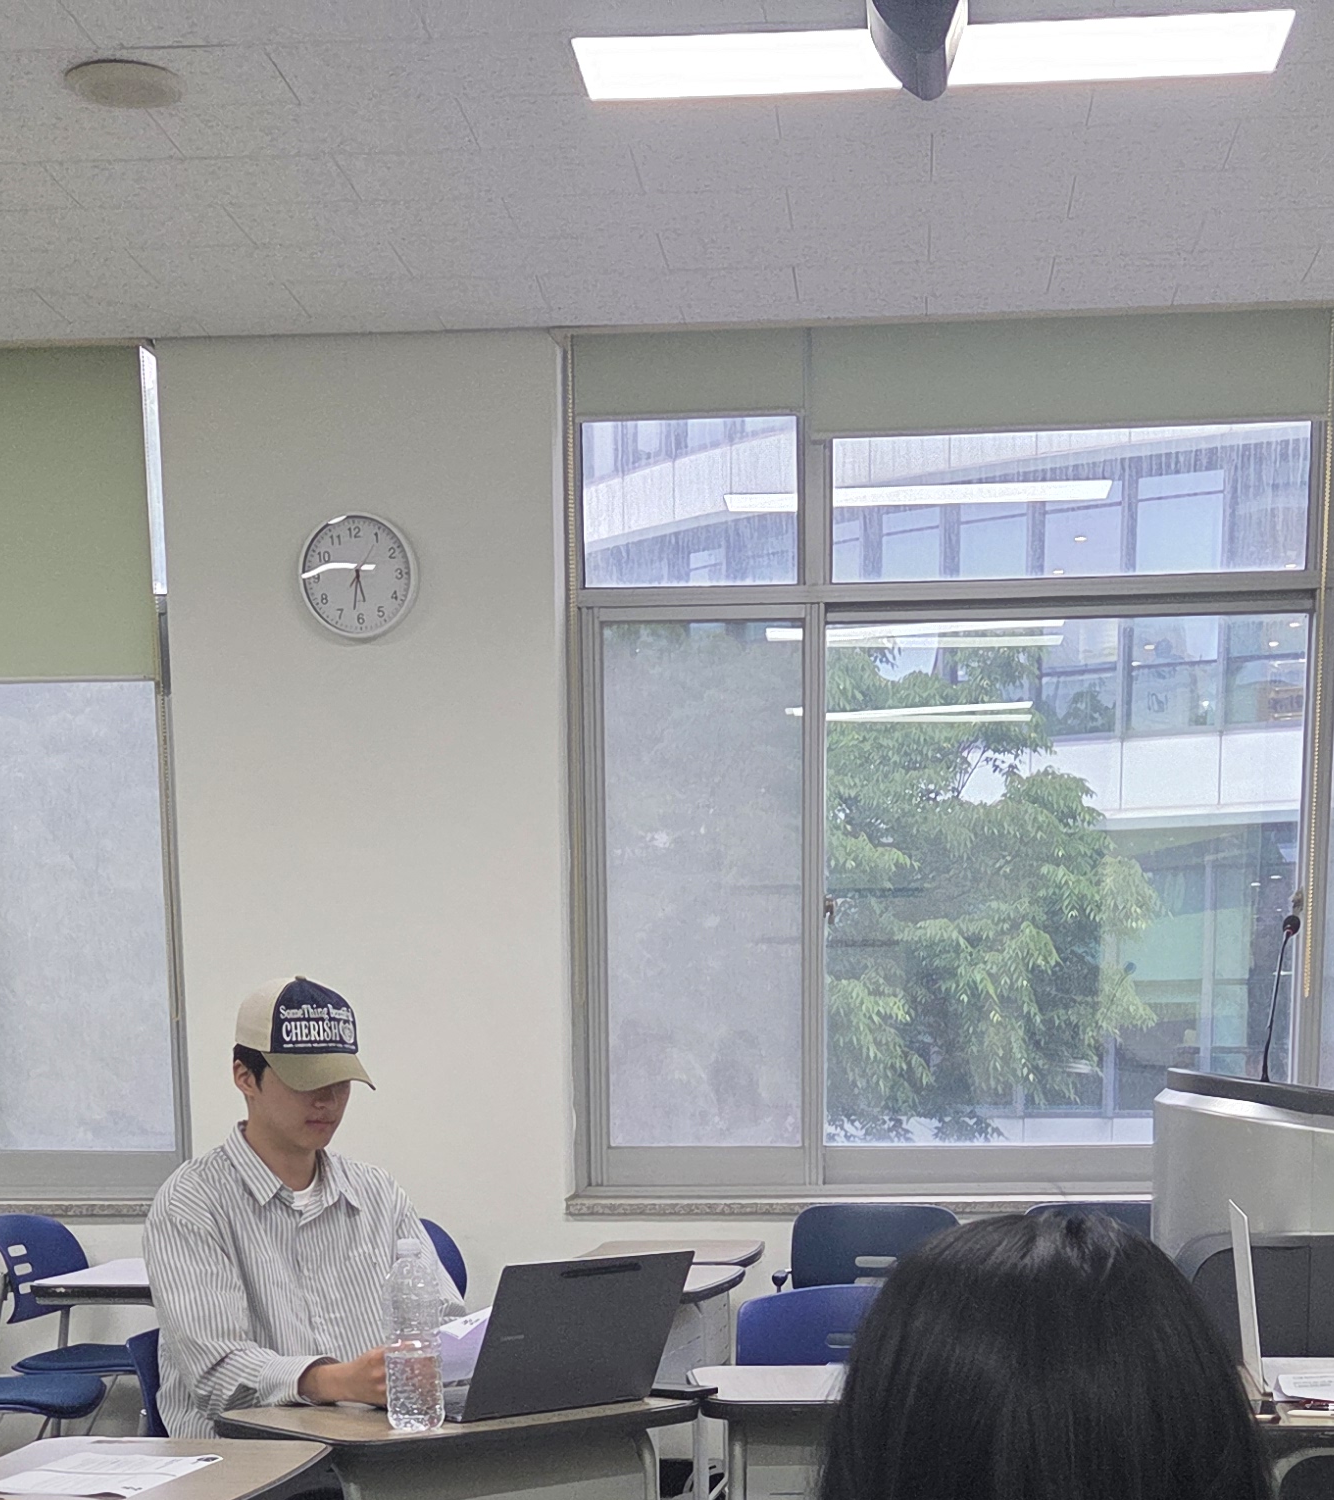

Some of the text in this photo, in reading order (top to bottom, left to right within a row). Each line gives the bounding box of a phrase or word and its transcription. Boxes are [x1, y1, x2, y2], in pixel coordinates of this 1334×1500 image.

[347, 526, 361, 539] 12
[373, 532, 379, 543] 1
[329, 534, 342, 546] 11
[317, 550, 331, 563] 10
[388, 547, 397, 559] 2
[394, 568, 404, 580] 3
[320, 593, 329, 605] 8
[390, 590, 399, 602] 4
[336, 608, 344, 620] 7
[376, 606, 385, 618] 5
[356, 613, 365, 625] 6
[282, 1020, 340, 1041] CHERISH
